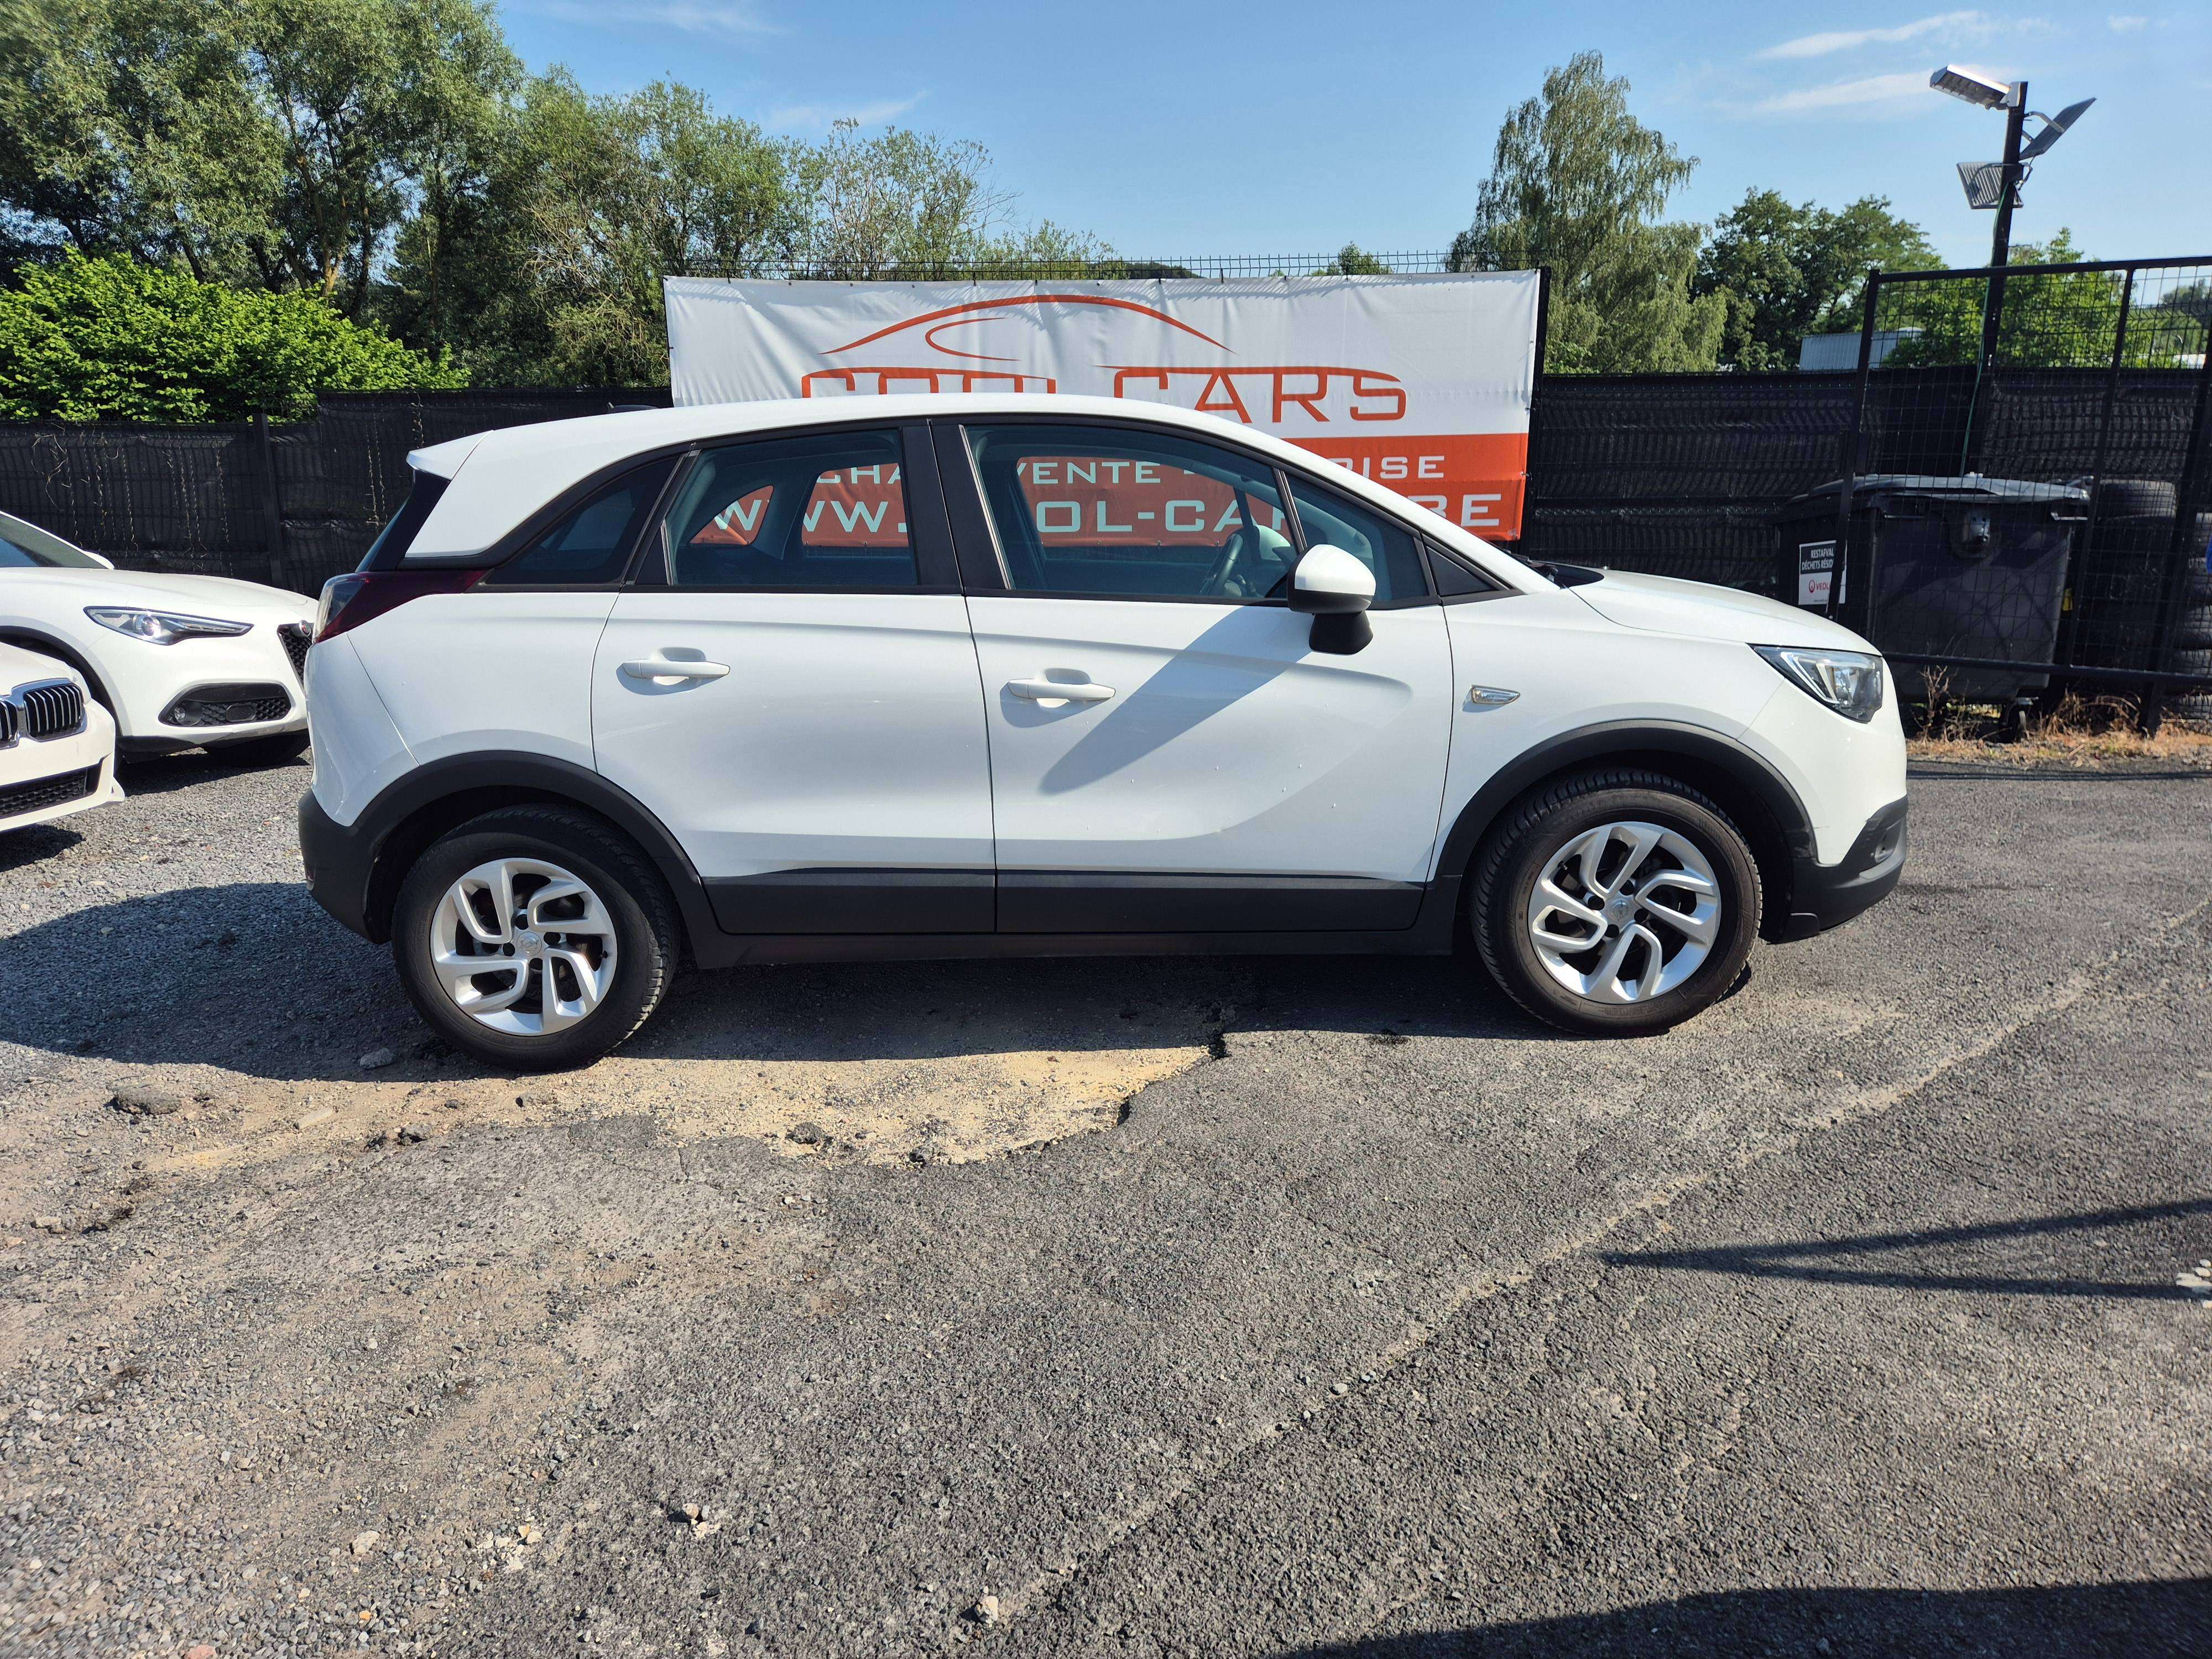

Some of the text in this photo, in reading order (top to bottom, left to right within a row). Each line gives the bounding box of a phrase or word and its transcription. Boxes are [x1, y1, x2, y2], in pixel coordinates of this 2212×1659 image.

[1811, 547, 1834, 559] RESTAFVAL
[1802, 557, 1834, 570] DÉCHETS RÉSID
[1816, 581, 1830, 591] VEOL
